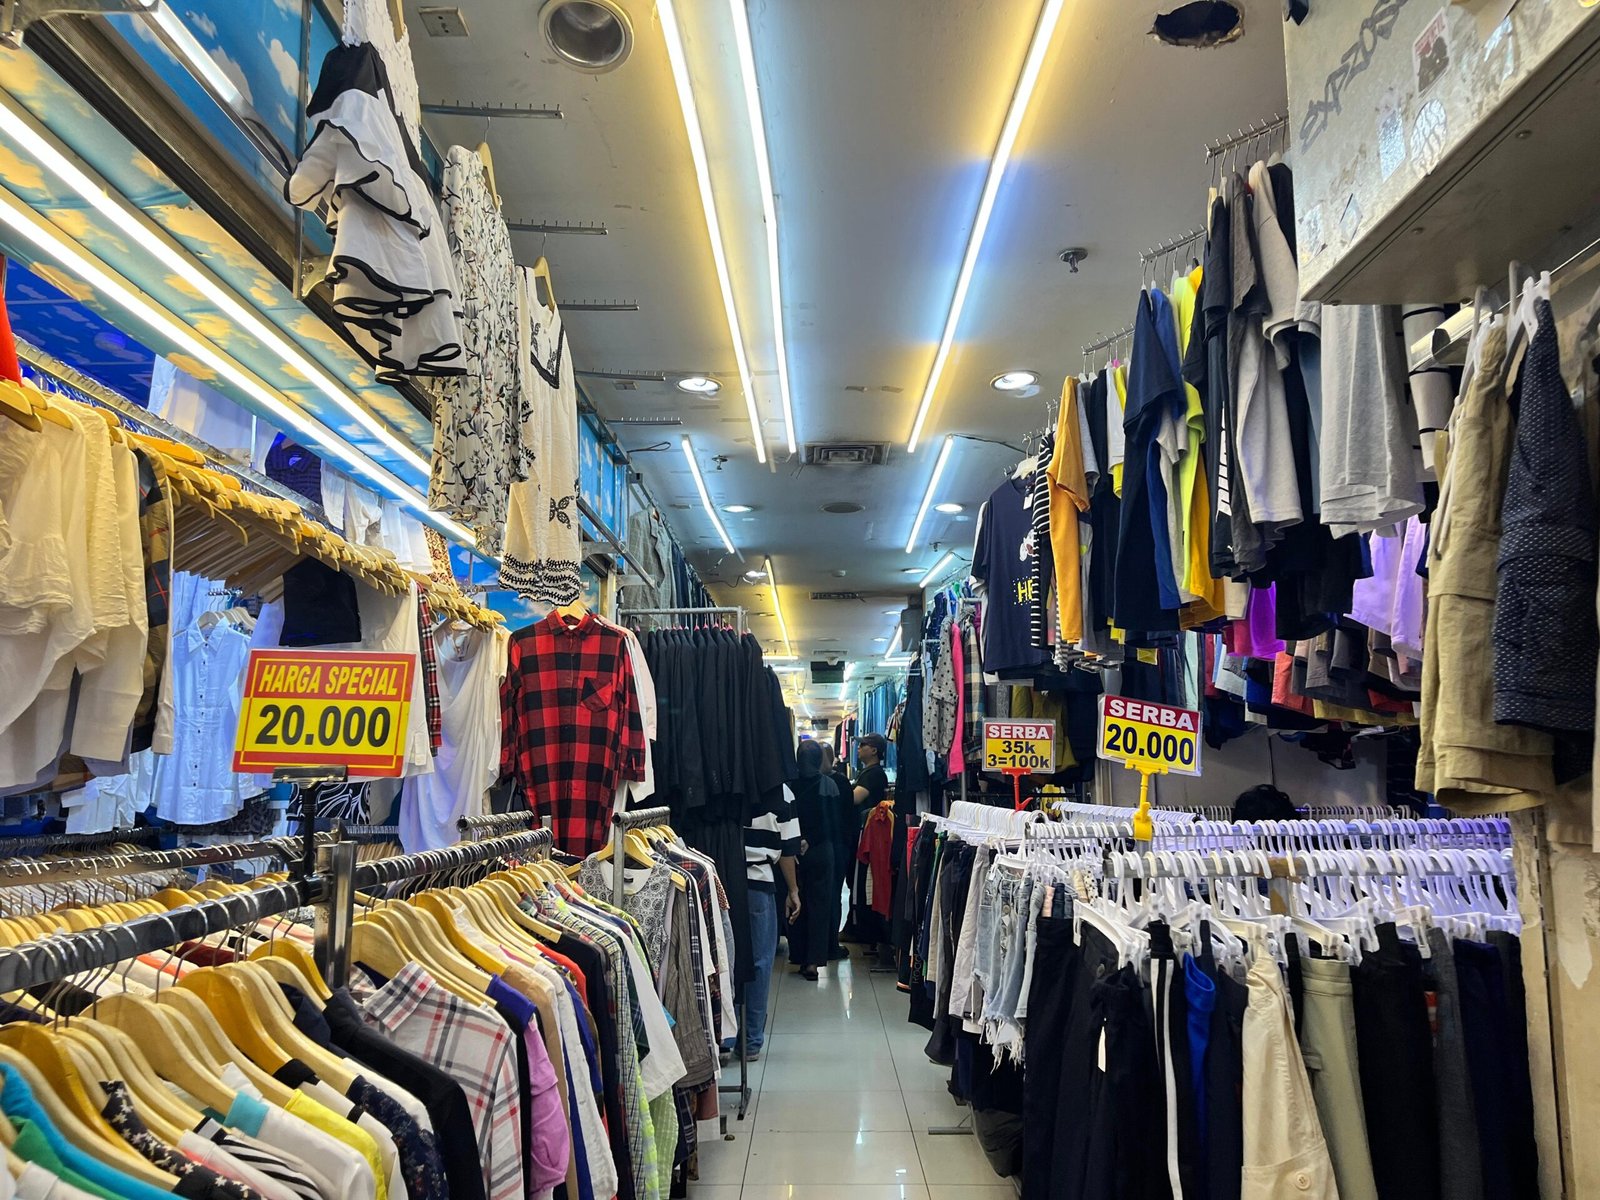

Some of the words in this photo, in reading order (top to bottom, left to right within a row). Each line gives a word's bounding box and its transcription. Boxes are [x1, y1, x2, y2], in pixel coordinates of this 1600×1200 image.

[258, 664, 321, 694] HARGA
[325, 665, 398, 696] SPECIAL
[255, 704, 391, 748] 20.000
[1109, 699, 1194, 731] SERBA
[988, 725, 1050, 740] SERBA
[1002, 740, 1036, 754] 35k
[1105, 723, 1194, 765] 20.000
[987, 754, 1050, 768] 3=100k
